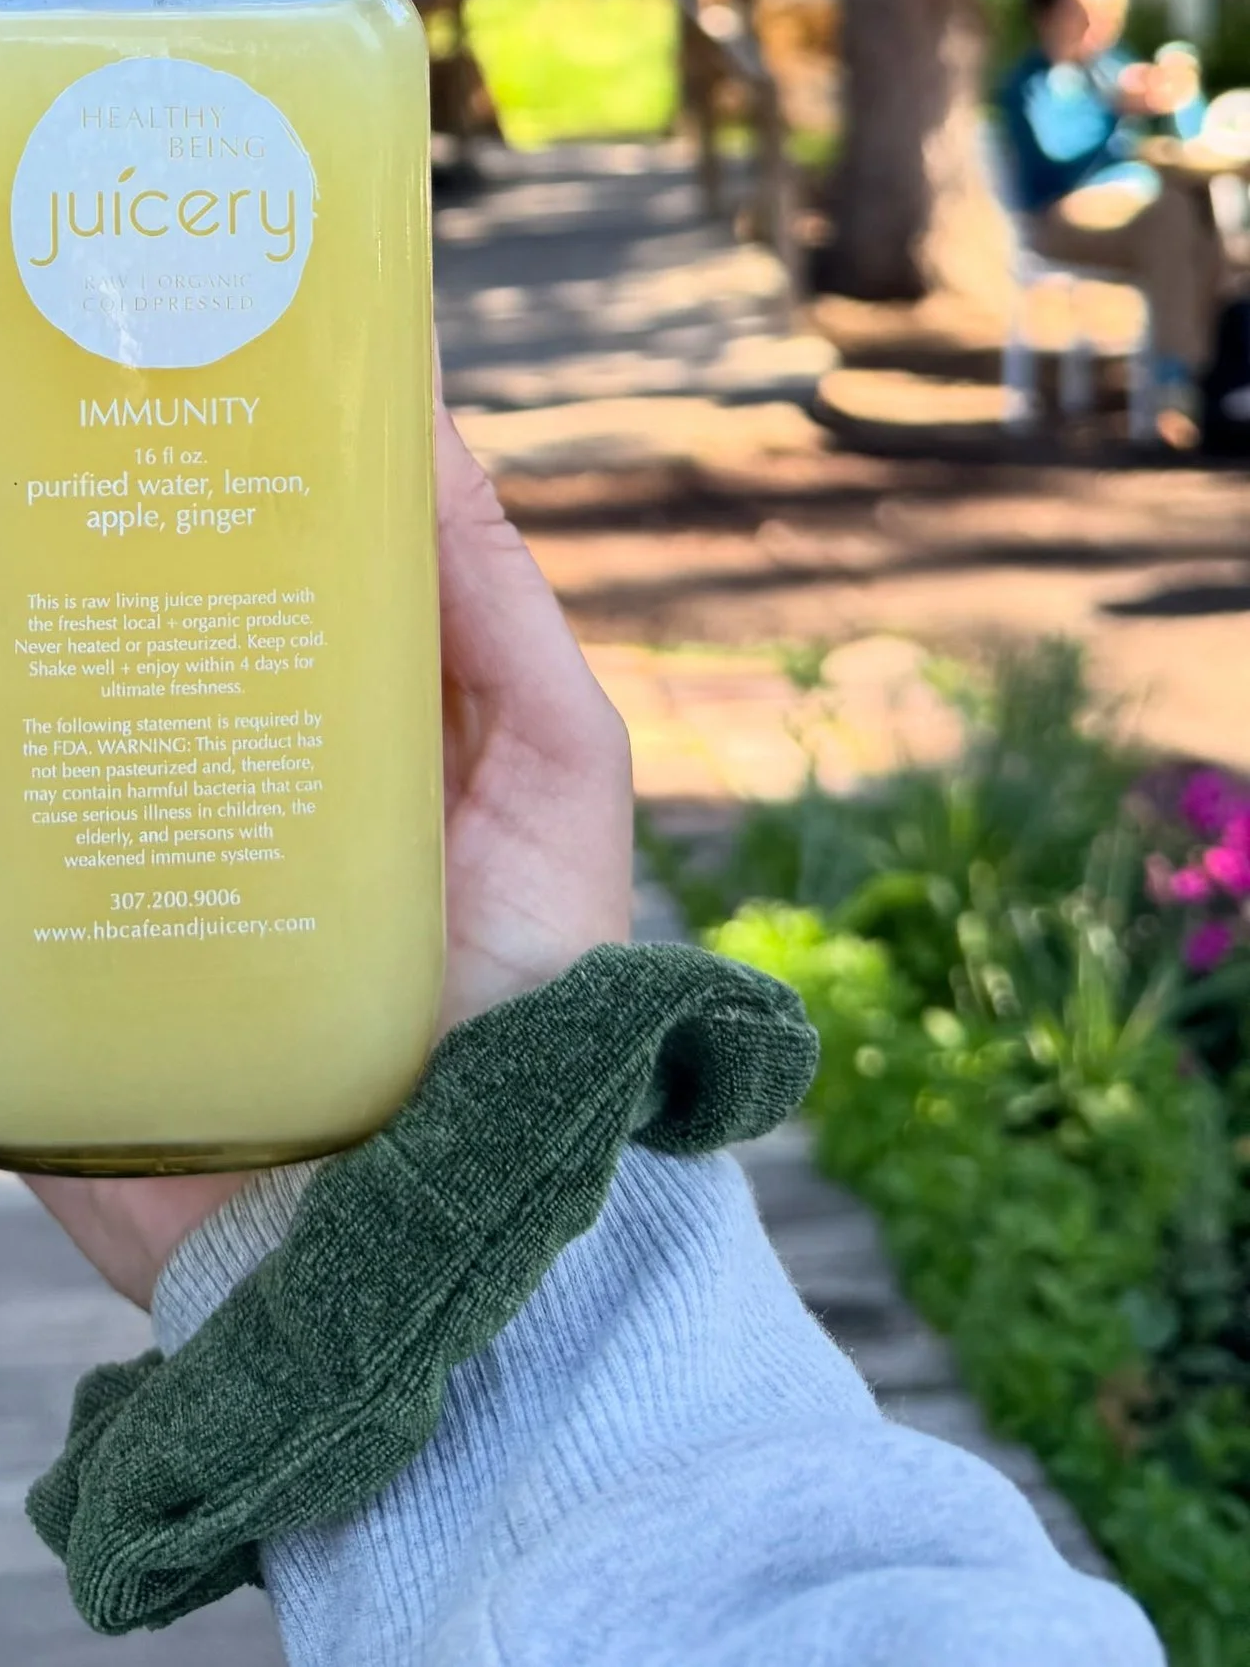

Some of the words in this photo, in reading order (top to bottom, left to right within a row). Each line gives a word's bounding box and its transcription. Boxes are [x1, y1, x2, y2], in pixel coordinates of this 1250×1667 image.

[82, 106, 226, 129] HEALTHY
[169, 136, 266, 158] BEING
[29, 166, 296, 266] juicery
[79, 397, 259, 427] IMMUNITY
[135, 447, 156, 464] 16
[163, 446, 173, 464] fl
[180, 450, 208, 464] oz.
[27, 471, 129, 506] purified
[138, 473, 214, 500] water,
[225, 470, 310, 497] lemon,
[86, 502, 166, 536] apple,
[176, 503, 256, 534] ginger
[27, 594, 59, 610] This
[64, 594, 76, 609] is
[82, 596, 110, 609] raw
[116, 593, 159, 612] living
[164, 592, 203, 610] juice
[208, 589, 277, 610] prepared
[282, 588, 315, 604] with
[28, 617, 53, 632] the
[59, 616, 117, 631] freshest
[123, 615, 161, 630] local
[182, 614, 240, 632] organic
[246, 612, 313, 631] produce.
[14, 639, 63, 654] Never
[67, 638, 121, 653] heated
[125, 640, 141, 652] or
[147, 634, 241, 656] pasteurized.
[248, 634, 285, 652] Keep
[290, 631, 327, 647] cold.
[29, 660, 76, 676] Shake
[81, 659, 115, 675] well
[137, 659, 179, 678] enjoy
[185, 657, 234, 673] within
[240, 657, 249, 671] 4
[255, 656, 289, 675] days
[294, 654, 315, 669] for
[101, 681, 165, 698] ultimate
[170, 679, 245, 695] freshness.
[23, 718, 52, 734] The
[56, 717, 131, 736] following
[136, 715, 211, 732] statement
[218, 714, 229, 729] is
[234, 713, 299, 732] required
[304, 710, 322, 729] by
[23, 741, 48, 757] the
[53, 740, 92, 755] FDA.
[97, 738, 190, 755] WARNING:
[195, 737, 226, 752] This
[232, 735, 292, 755] product
[297, 732, 323, 748] has
[31, 765, 57, 779] not
[62, 762, 100, 778] been
[106, 759, 197, 781] pasteurized
[202, 759, 236, 776] and,
[241, 756, 314, 774] therefore,
[24, 788, 57, 806] may
[62, 785, 122, 801] contain
[127, 782, 188, 799] harmful
[193, 781, 256, 796] bacteria
[261, 780, 290, 793] that
[295, 780, 323, 792] can
[32, 810, 78, 824] cause
[82, 806, 138, 822] serious
[143, 804, 192, 821] illness
[198, 803, 212, 818] in
[217, 802, 285, 819] children,
[292, 800, 316, 815] the
[75, 829, 133, 848] elderly,
[139, 828, 169, 844] and
[174, 826, 234, 846] persons
[239, 824, 274, 839] with
[64, 851, 145, 868] weakened
[151, 848, 216, 865] immune
[221, 847, 285, 866] systems.
[110, 889, 241, 911] 307.200.9006
[34, 916, 316, 942] www.hbcafeandjuicery.com
